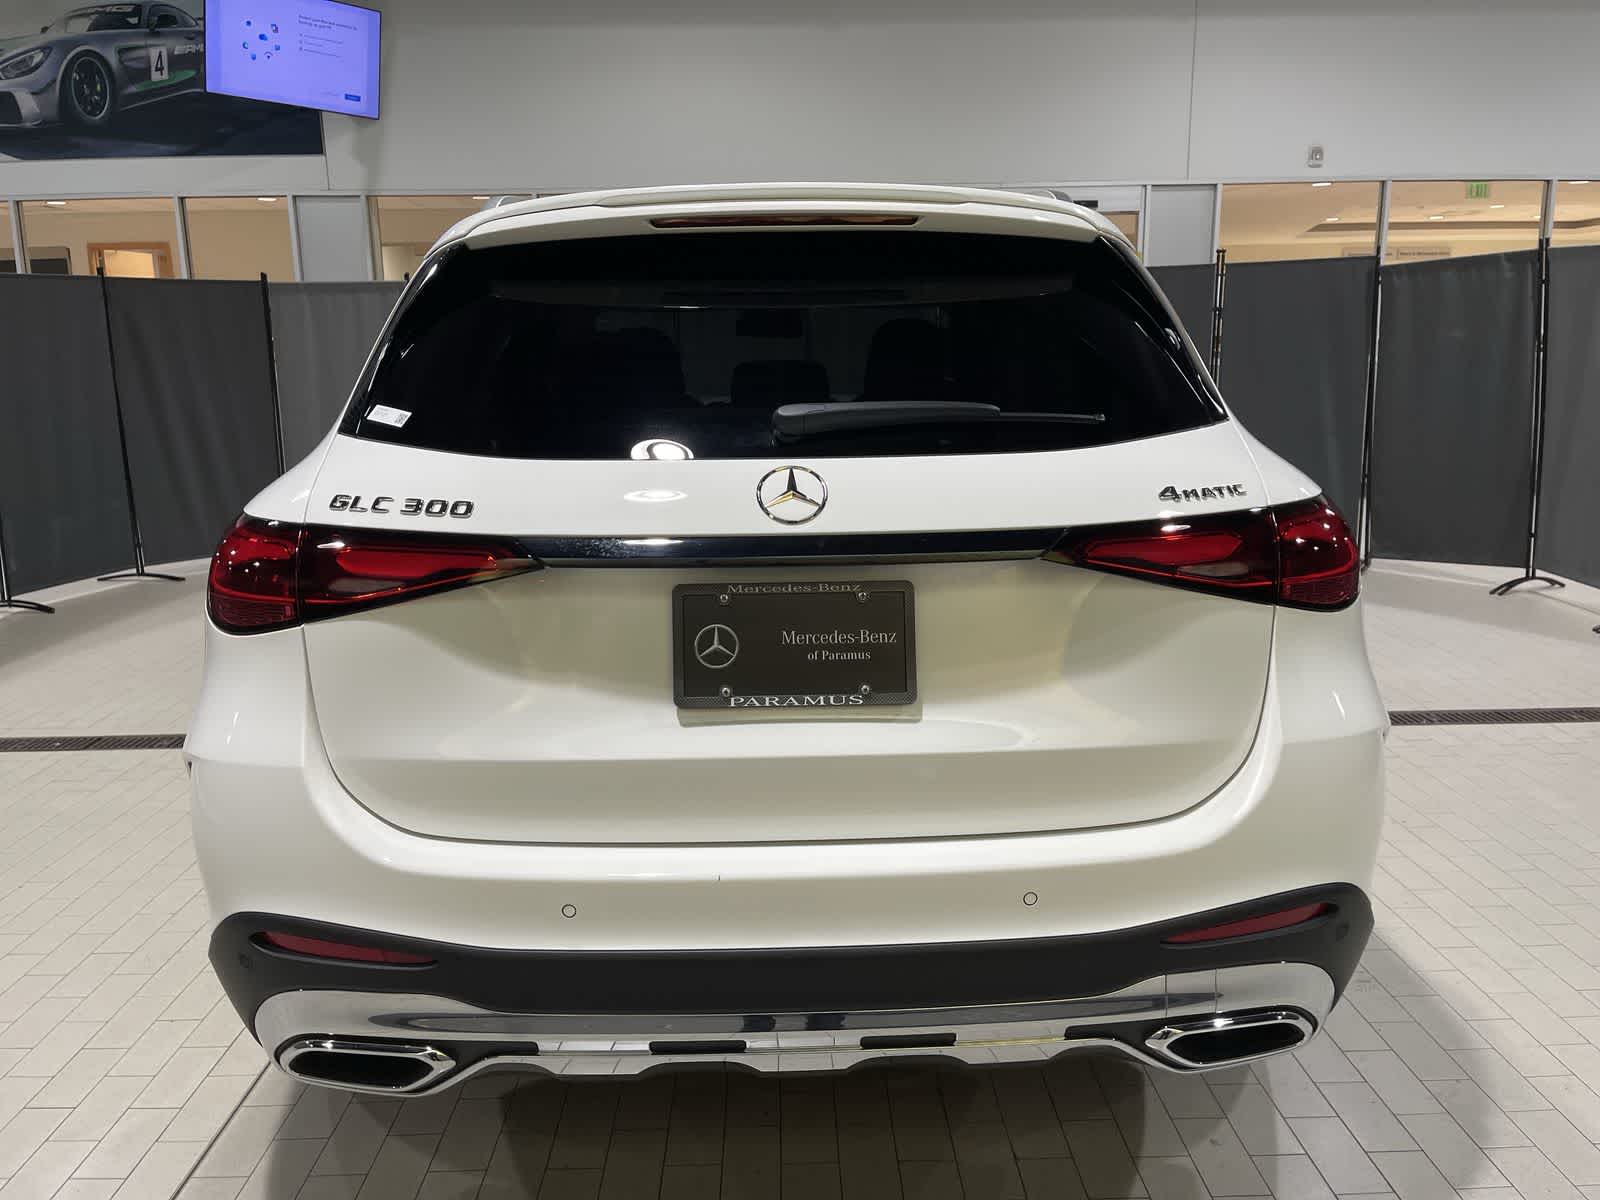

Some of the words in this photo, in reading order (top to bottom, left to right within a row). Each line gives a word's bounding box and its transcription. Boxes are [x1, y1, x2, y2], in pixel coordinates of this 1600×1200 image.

[155, 51, 165, 76] 4
[1158, 484, 1248, 503] 4MATIC
[329, 494, 394, 513] GLC
[400, 498, 475, 519] 300
[727, 583, 863, 594] Mercedes-Benz
[781, 629, 897, 645] Mercedes-Benz
[807, 650, 818, 660] of
[822, 650, 872, 661] Paramus
[729, 694, 864, 707] PARAMUS
